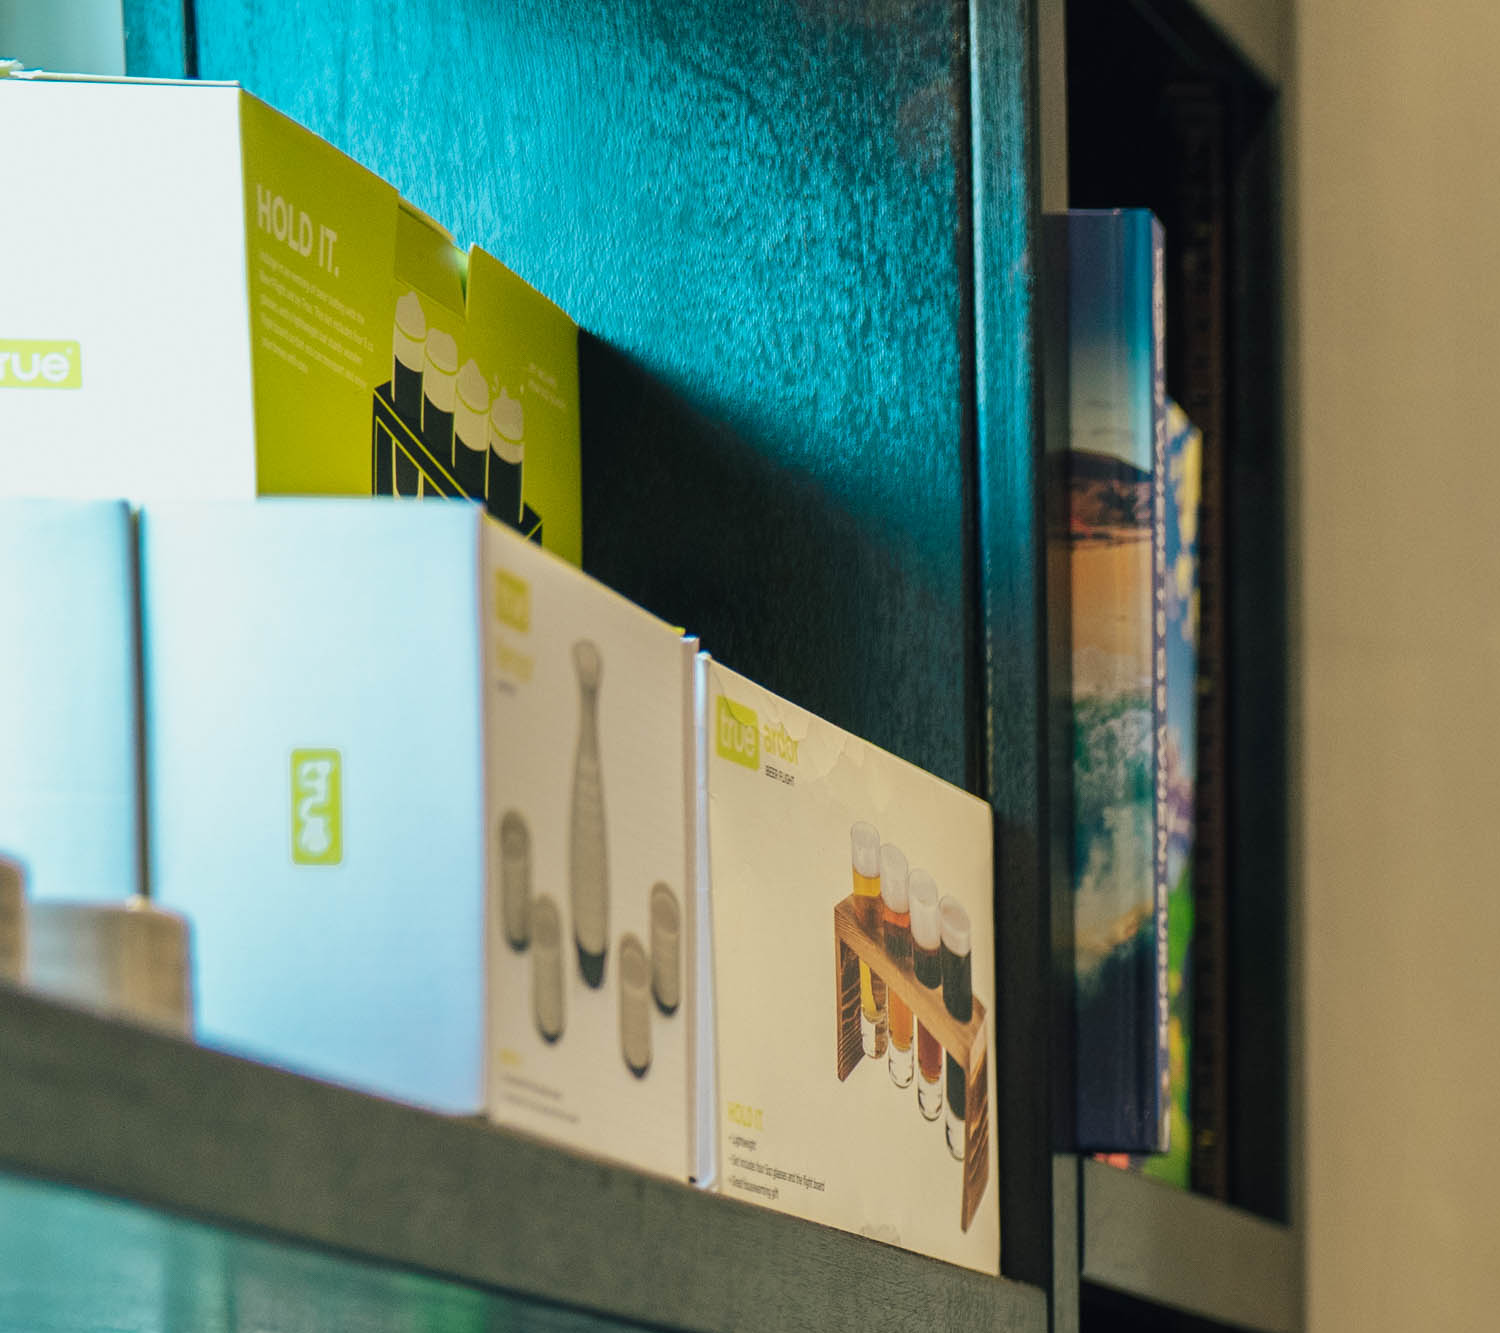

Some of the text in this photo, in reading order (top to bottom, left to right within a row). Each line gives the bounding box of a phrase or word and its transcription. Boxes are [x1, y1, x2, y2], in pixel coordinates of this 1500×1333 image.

[257, 184, 340, 278] HOLD IT.
[721, 707, 756, 758] true
